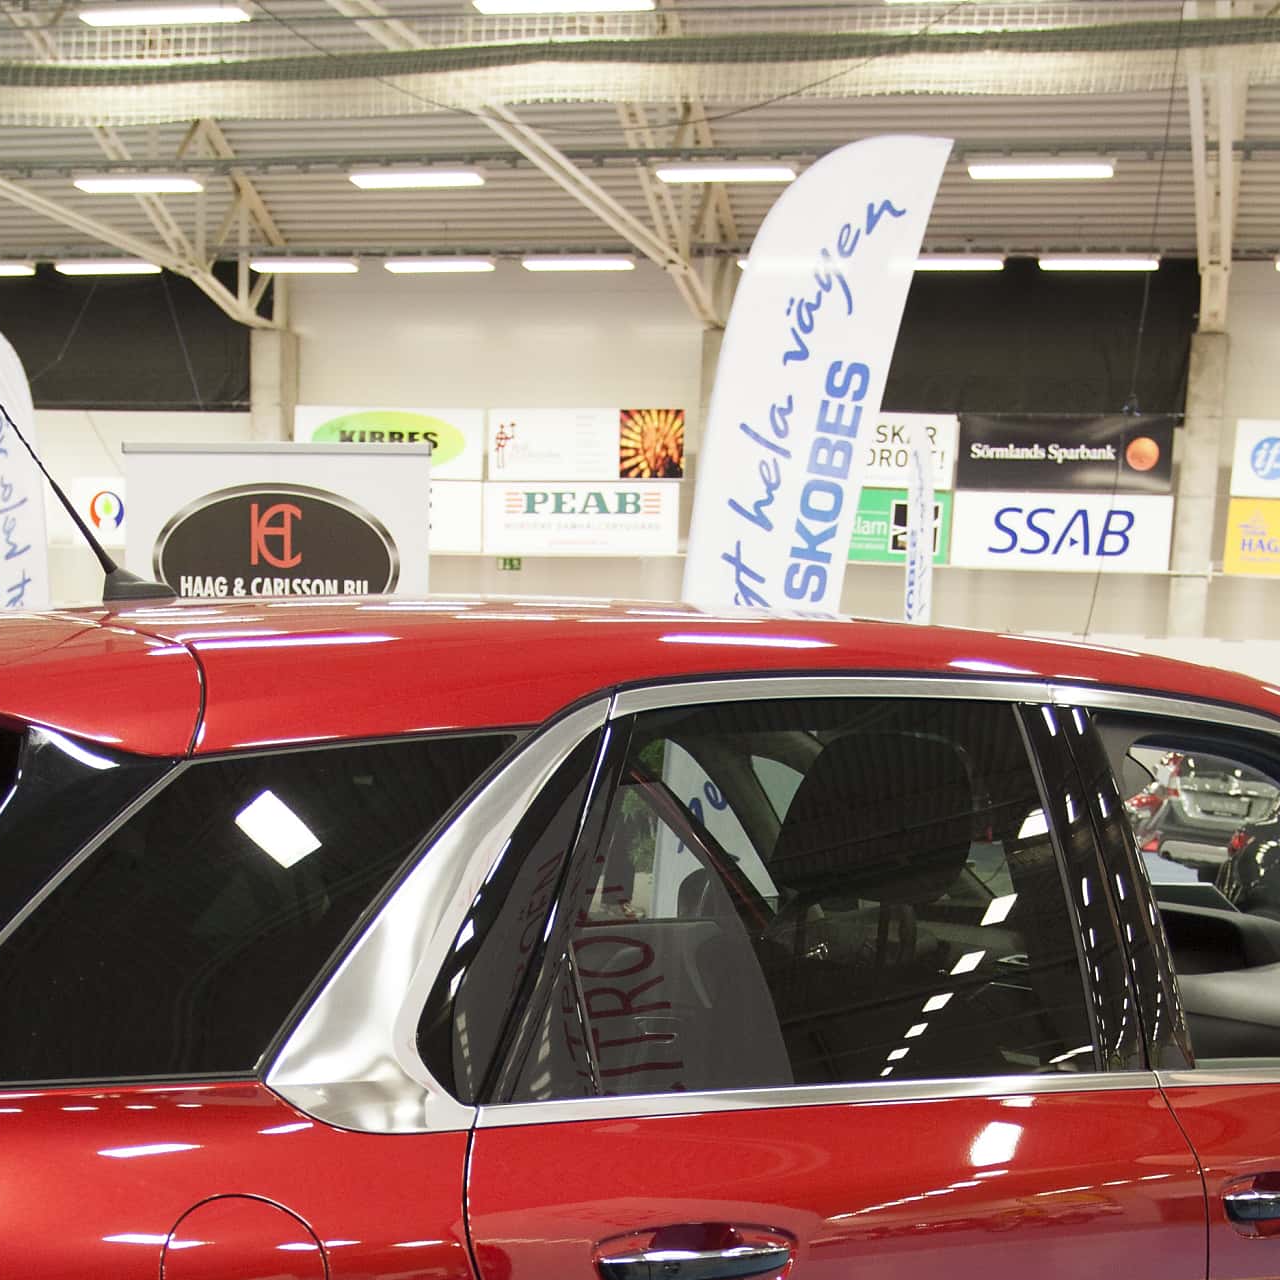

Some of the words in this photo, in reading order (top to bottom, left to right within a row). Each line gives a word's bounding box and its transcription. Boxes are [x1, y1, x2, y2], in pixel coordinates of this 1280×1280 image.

[727, 395, 794, 532] hela
[784, 197, 907, 367] vägen
[970, 443, 1046, 461] Sörmlands
[1047, 444, 1117, 465] Sparbank
[784, 360, 871, 603] SKOBES
[524, 491, 643, 515] PEAB
[988, 506, 1136, 557] SSAB
[180, 575, 228, 597] HAAG
[233, 576, 247, 597] &
[251, 576, 338, 597] CARLSSON
